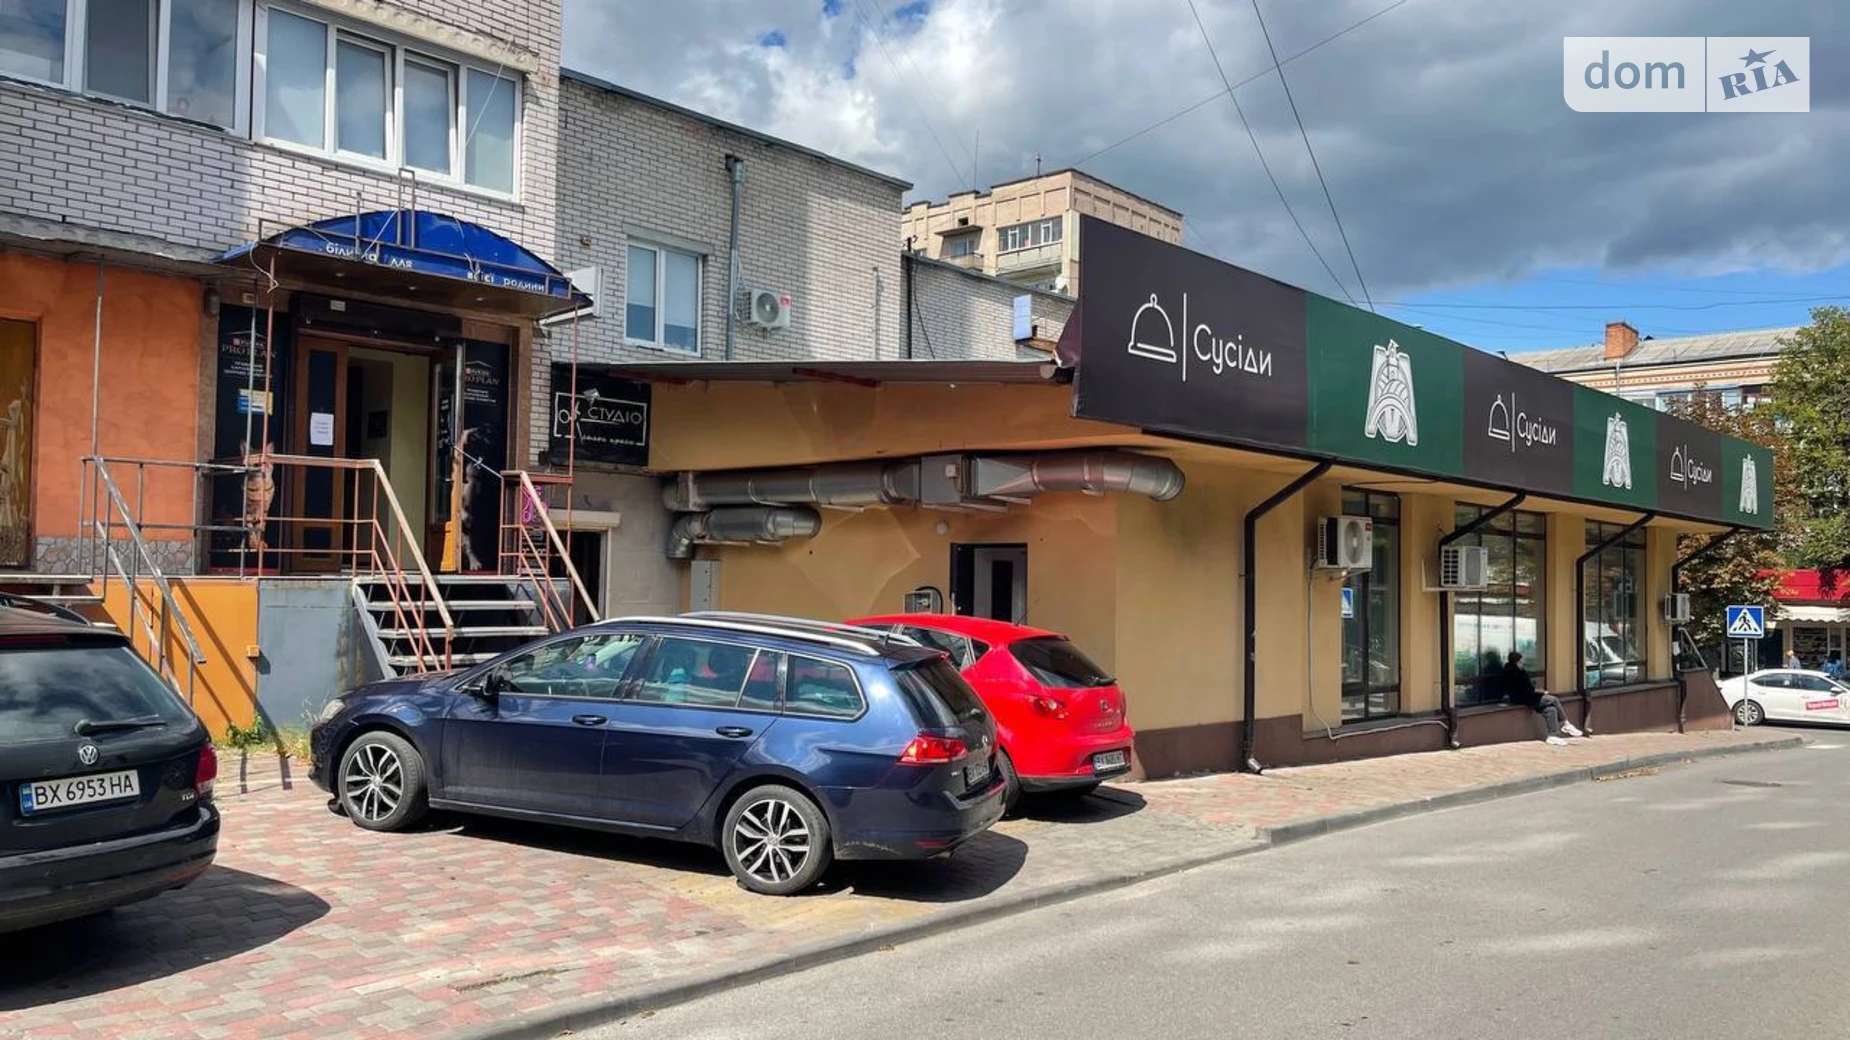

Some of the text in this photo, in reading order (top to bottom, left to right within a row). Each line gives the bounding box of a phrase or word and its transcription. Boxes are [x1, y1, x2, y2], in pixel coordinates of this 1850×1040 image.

[503, 278, 545, 293] родини
[1193, 324, 1272, 376] Сусіди
[35, 774, 134, 806] BX 6953 HA
